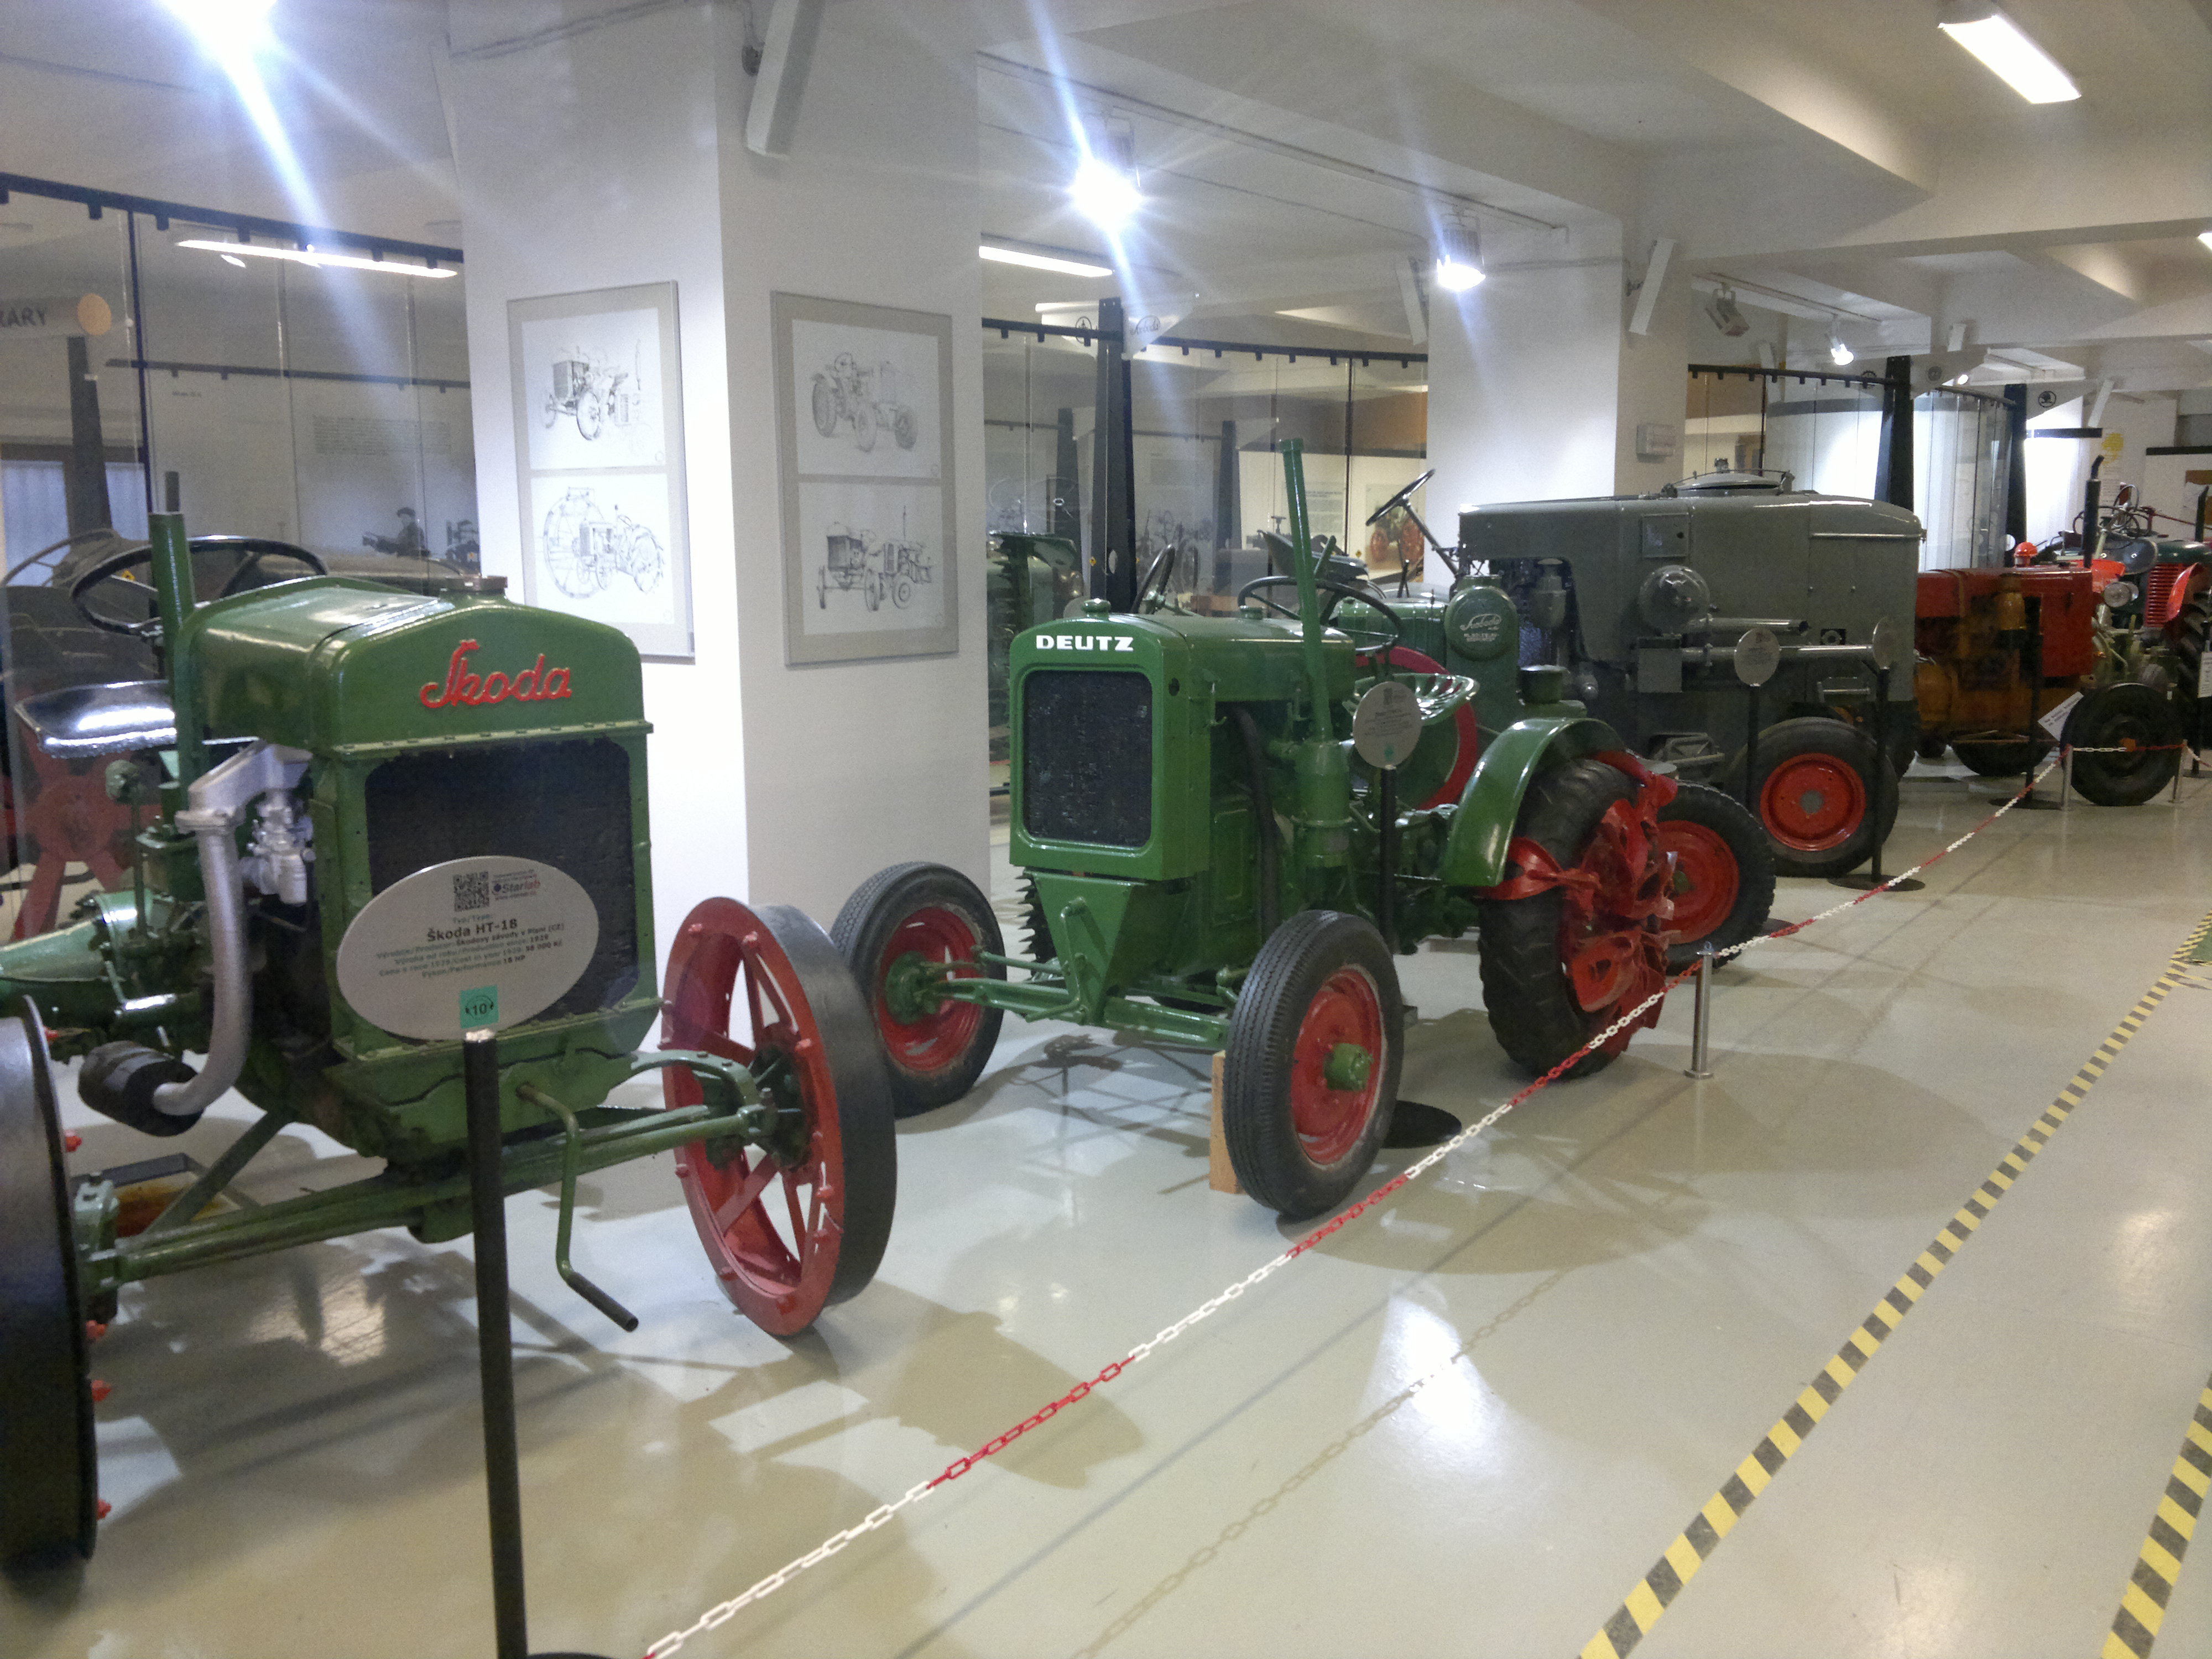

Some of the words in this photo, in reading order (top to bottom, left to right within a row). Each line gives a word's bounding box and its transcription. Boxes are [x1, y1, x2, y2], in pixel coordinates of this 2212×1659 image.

[1036, 635, 1134, 651] DEUTZ
[426, 926, 471, 942] Škoda
[475, 918, 518, 934] HT-18
[473, 1004, 487, 1016] 10
